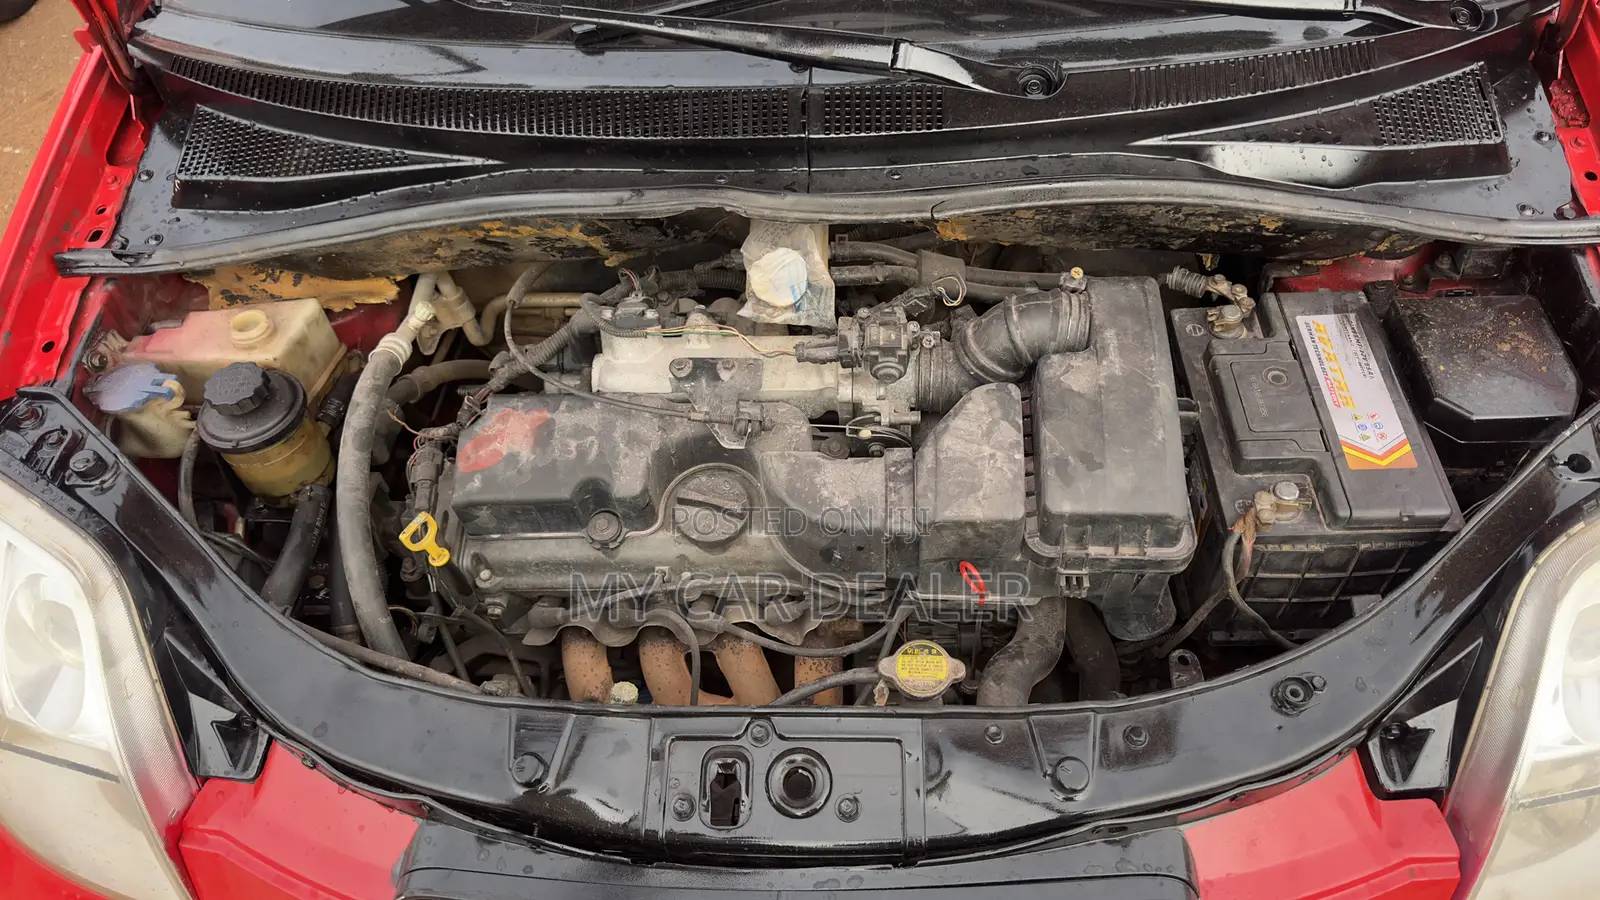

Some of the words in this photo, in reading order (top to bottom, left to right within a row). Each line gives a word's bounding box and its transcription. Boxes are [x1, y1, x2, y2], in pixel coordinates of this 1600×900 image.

[1304, 321, 1316, 343] GERMAN
[1313, 344, 1328, 377] TECHNOLOGY
[1326, 378, 1340, 408] BATTERY
[1312, 320, 1356, 410] AVATAR
